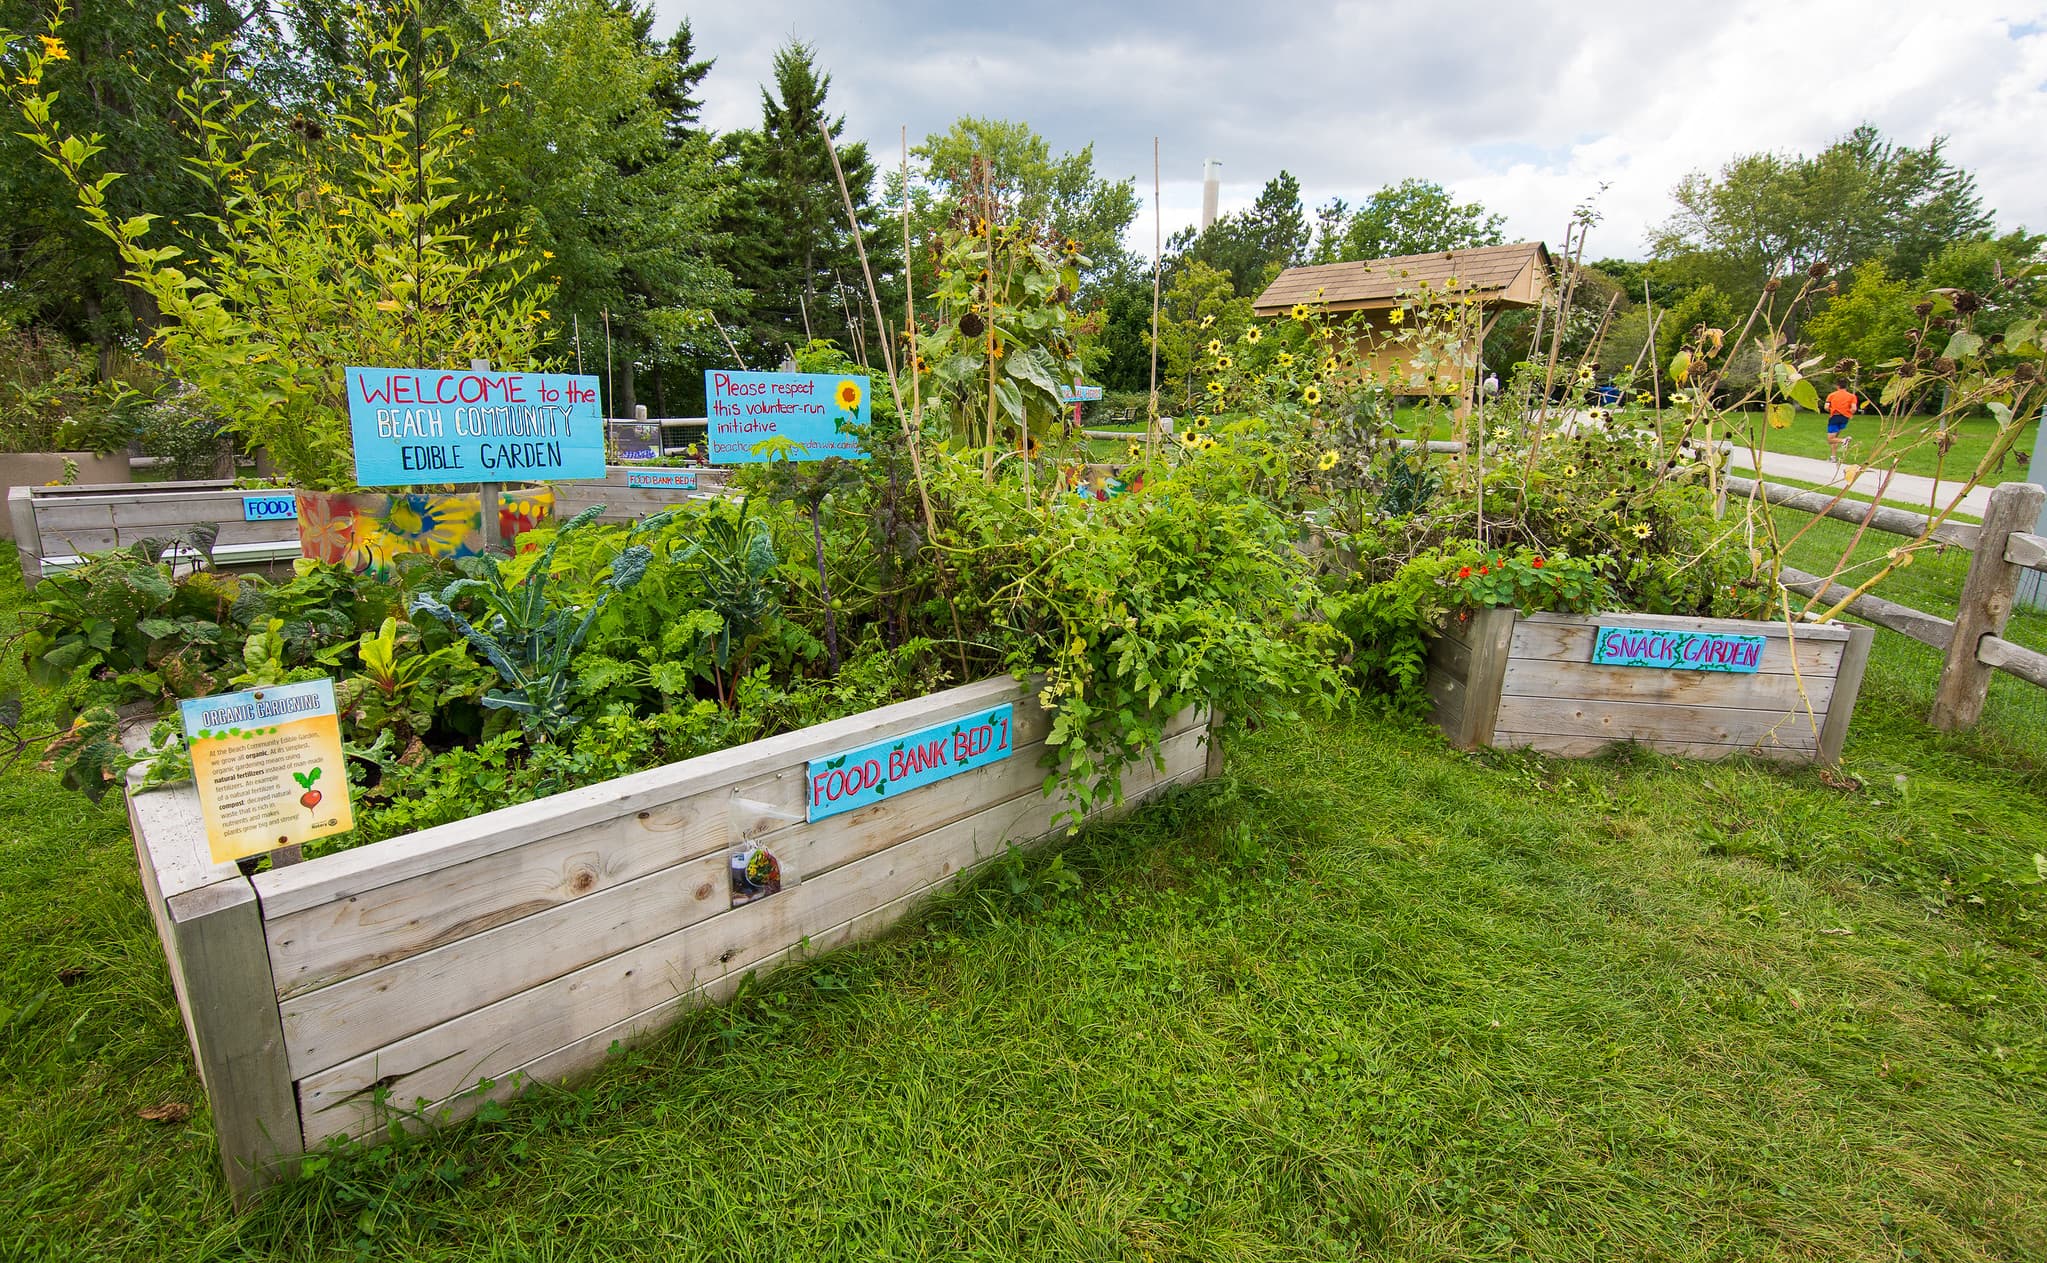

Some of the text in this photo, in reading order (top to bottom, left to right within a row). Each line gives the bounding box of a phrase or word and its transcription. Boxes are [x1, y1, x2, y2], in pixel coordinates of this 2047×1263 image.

[359, 374, 596, 404] WELCOME to the
[714, 373, 814, 398] Please respect
[713, 398, 825, 416] this volunteer-run
[377, 405, 573, 438] BEACH COMMUNITY
[718, 418, 776, 433] initiative
[402, 441, 562, 470] EDIBLE GARDEN
[630, 476, 651, 484] FOOD
[652, 476, 672, 484] BANK
[675, 476, 689, 484] BED
[249, 501, 289, 515] FOOD
[1605, 633, 1760, 667] SNACK GARDEN
[203, 694, 320, 727] ORGANIC GARDENING
[247, 740, 279, 750] Community
[280, 736, 297, 744] Edible
[246, 751, 268, 759] organic.
[813, 718, 1008, 806] FOOD BANK BED 1
[212, 766, 234, 775] organic
[235, 760, 264, 770] gardening
[215, 775, 235, 783] natural
[237, 770, 264, 779] fertilizers
[266, 765, 288, 773] instead
[255, 776, 278, 785] example
[230, 790, 250, 798] natural
[252, 785, 274, 794] fertilizer
[272, 791, 291, 799] natural
[221, 811, 237, 819] waste
[222, 819, 248, 827] nutrients
[224, 827, 242, 837] plants
[243, 824, 257, 832] grow
